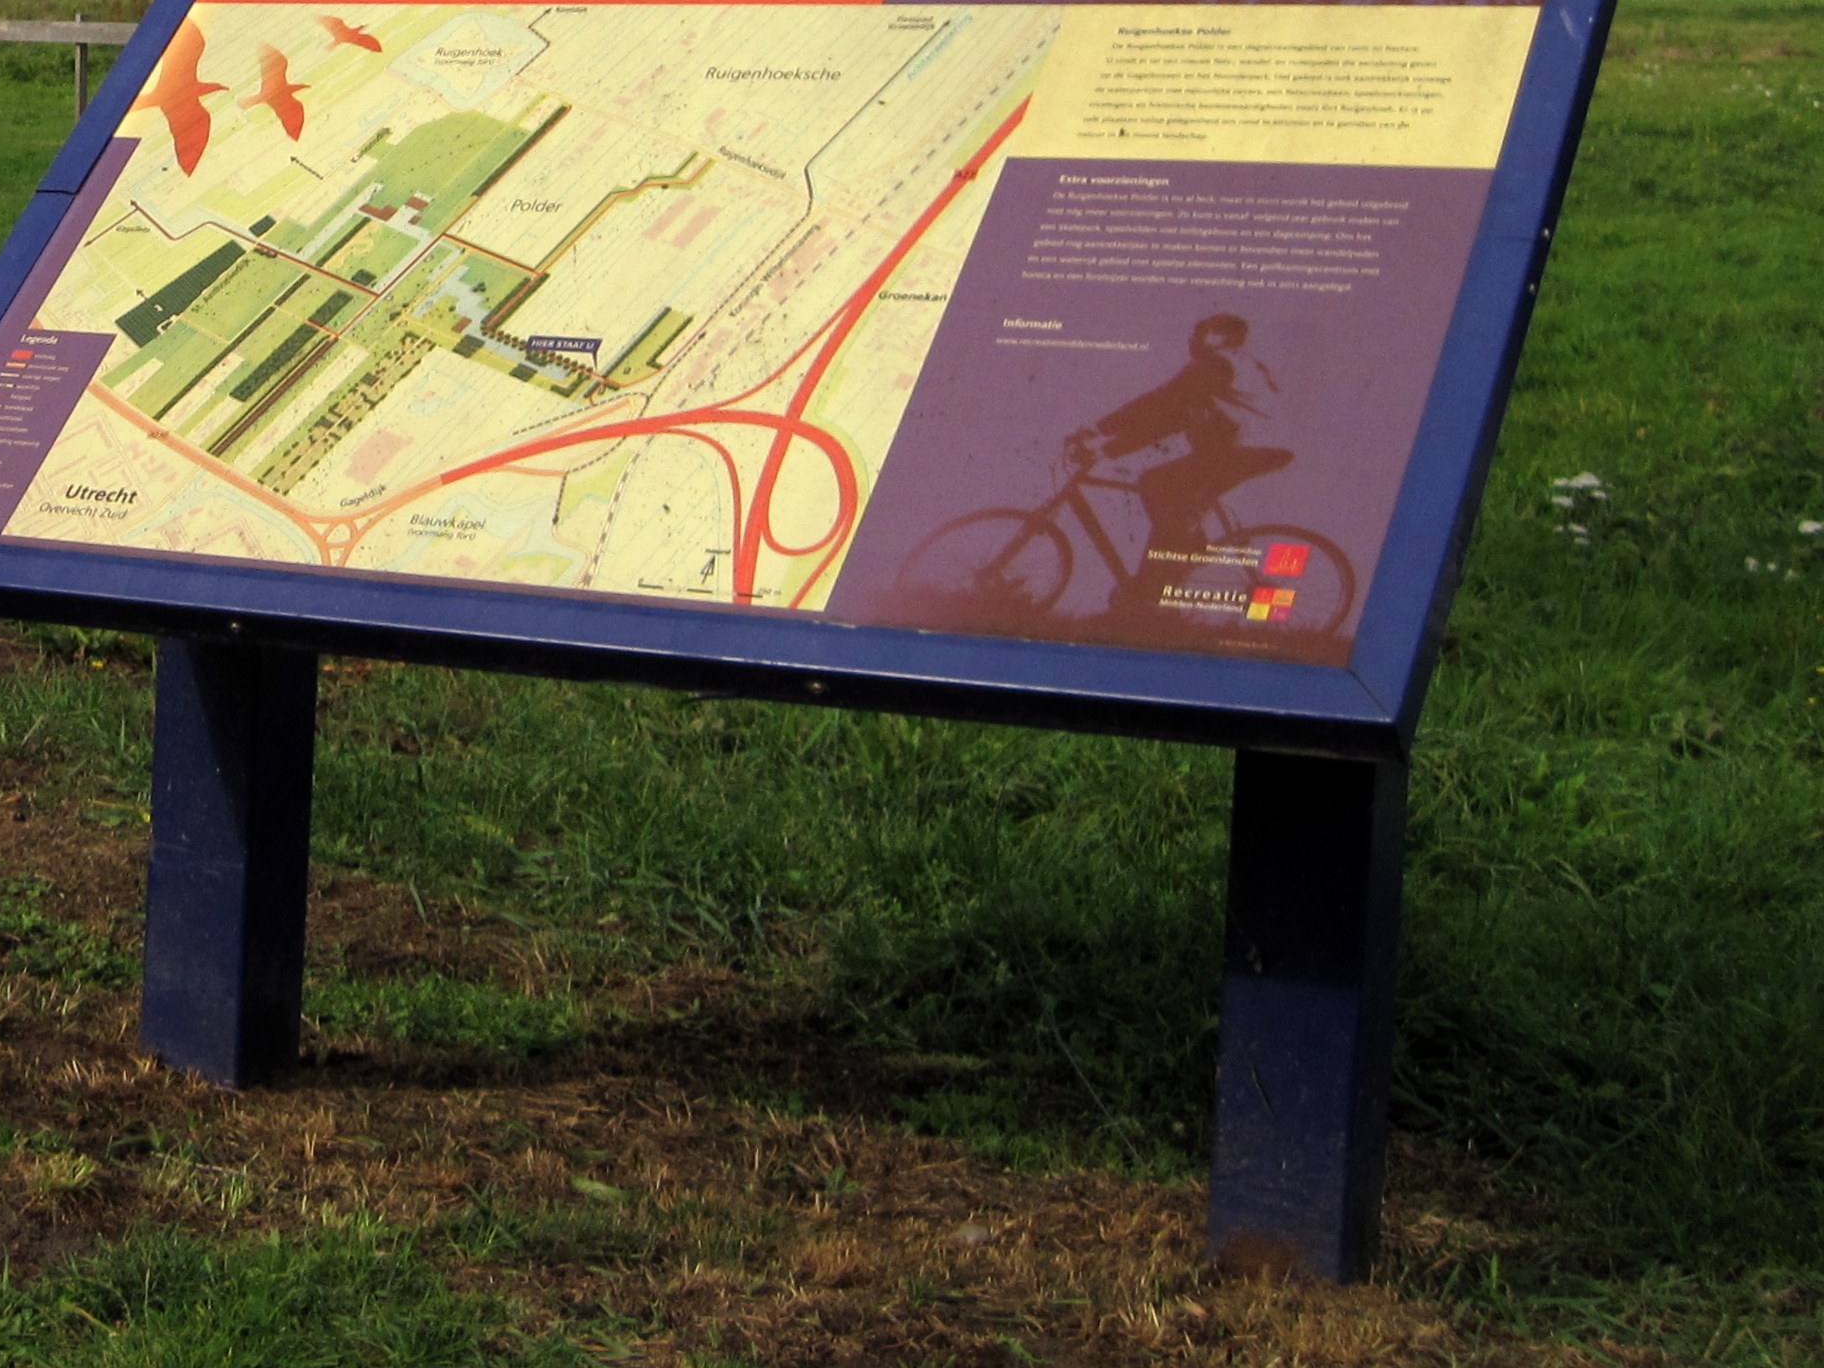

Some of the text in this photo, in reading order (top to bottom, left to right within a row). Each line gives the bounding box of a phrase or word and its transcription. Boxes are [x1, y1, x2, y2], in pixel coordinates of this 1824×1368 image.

[434, 46, 504, 60] Ruigenhoek
[705, 66, 842, 82] Ruigenhoeksche
[1059, 174, 1170, 189] Extra voorzieningen
[510, 198, 564, 213] Polder
[878, 290, 948, 302] Groenekan
[1002, 317, 1063, 330] Informatie
[20, 334, 59, 345] Legenda
[530, 339, 595, 350] HIER STAAT U
[65, 483, 138, 505] Utrecht
[339, 483, 388, 507] Gageldijk
[38, 501, 129, 520] Overvecht Zuid
[409, 513, 487, 530] Blauwkapel
[1147, 549, 1259, 567] Stichtse Groenlanden
[1161, 584, 1248, 603] Recreatie
